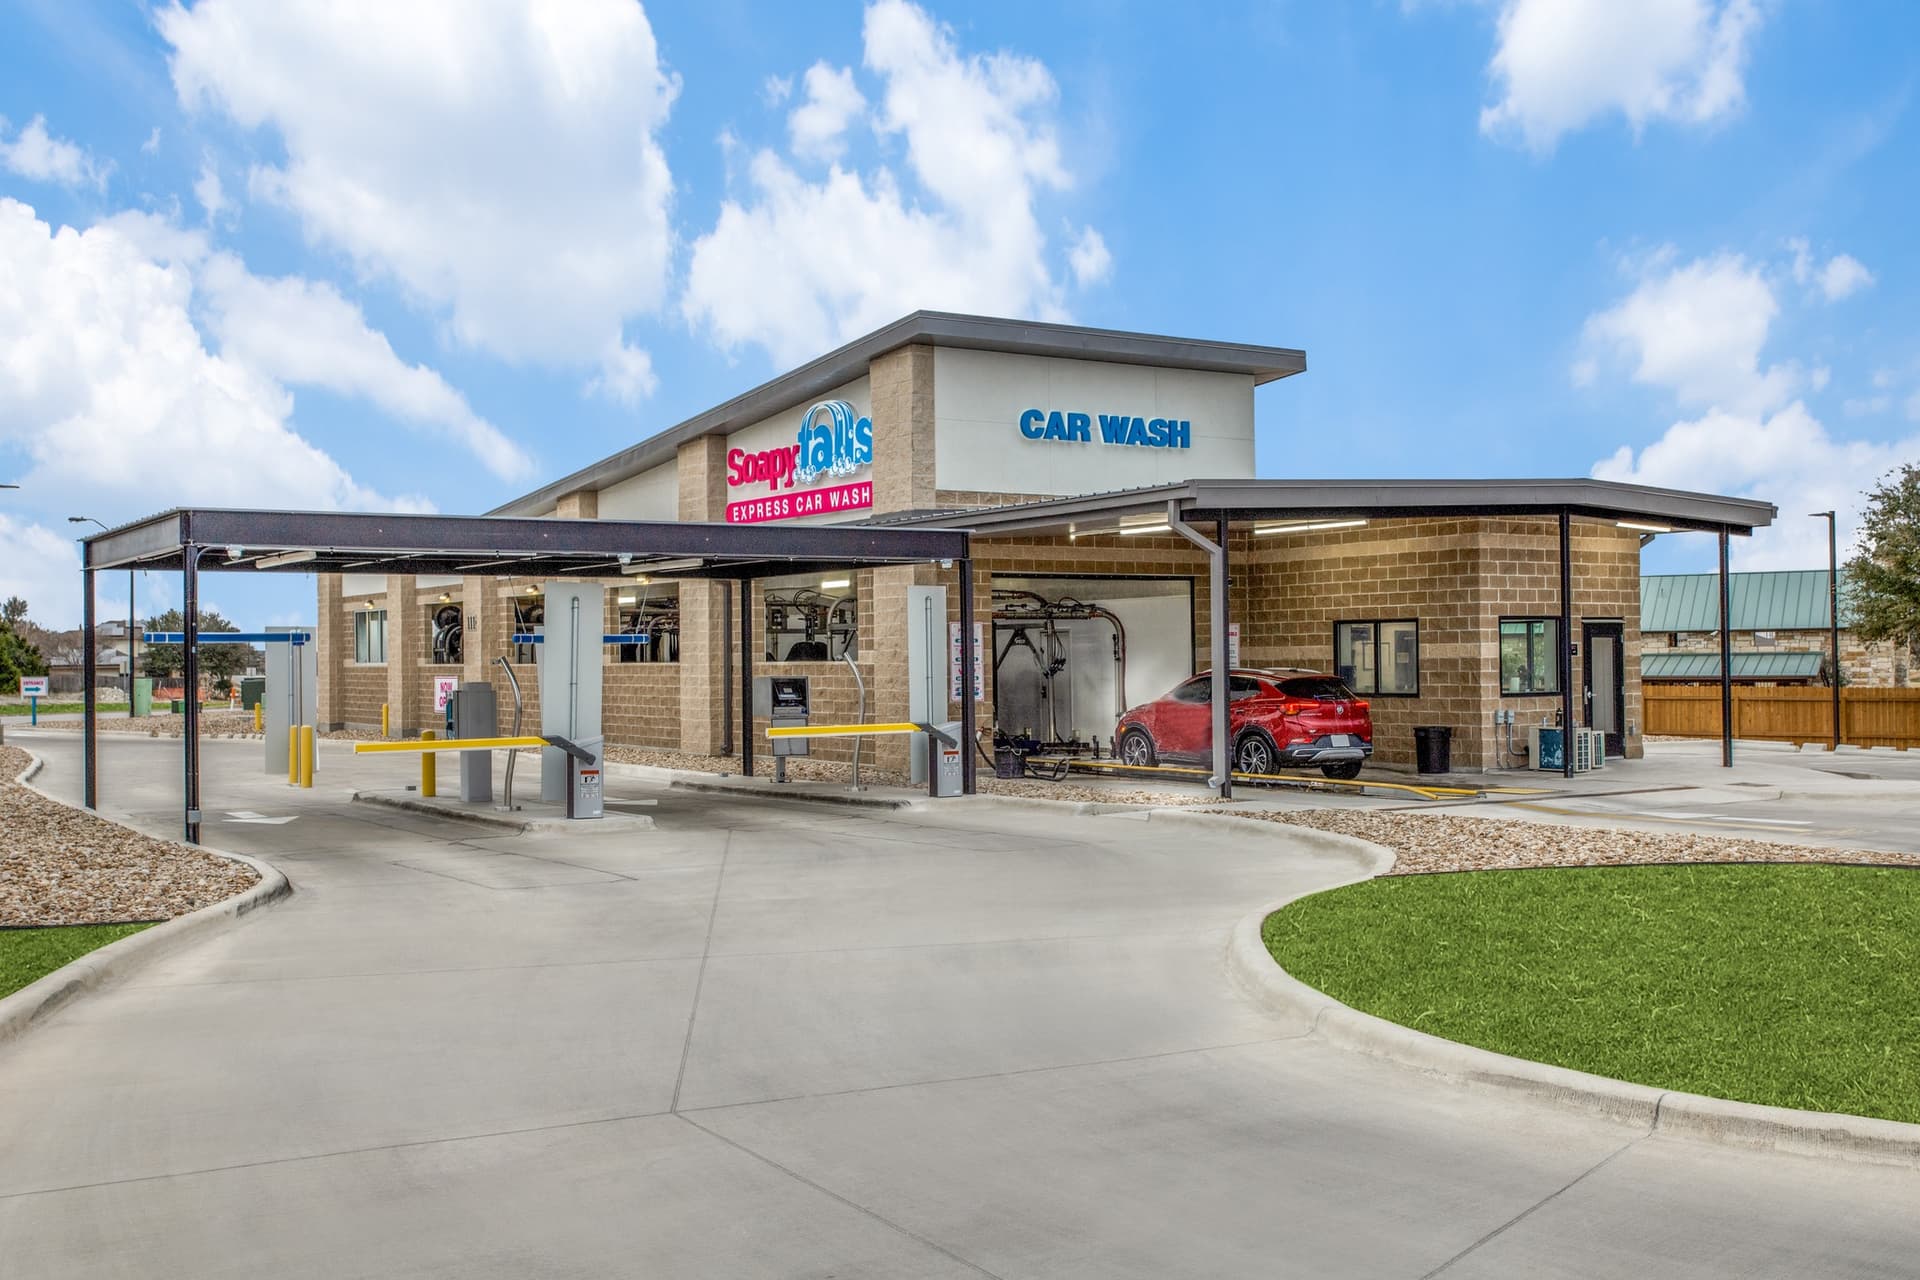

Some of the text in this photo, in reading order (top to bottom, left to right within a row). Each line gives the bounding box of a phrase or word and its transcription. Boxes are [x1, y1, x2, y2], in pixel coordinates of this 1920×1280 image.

[1020, 409, 1190, 448] CAR WASH
[727, 444, 800, 490] Soapy
[733, 486, 870, 522] EXPRESS CAR WASH
